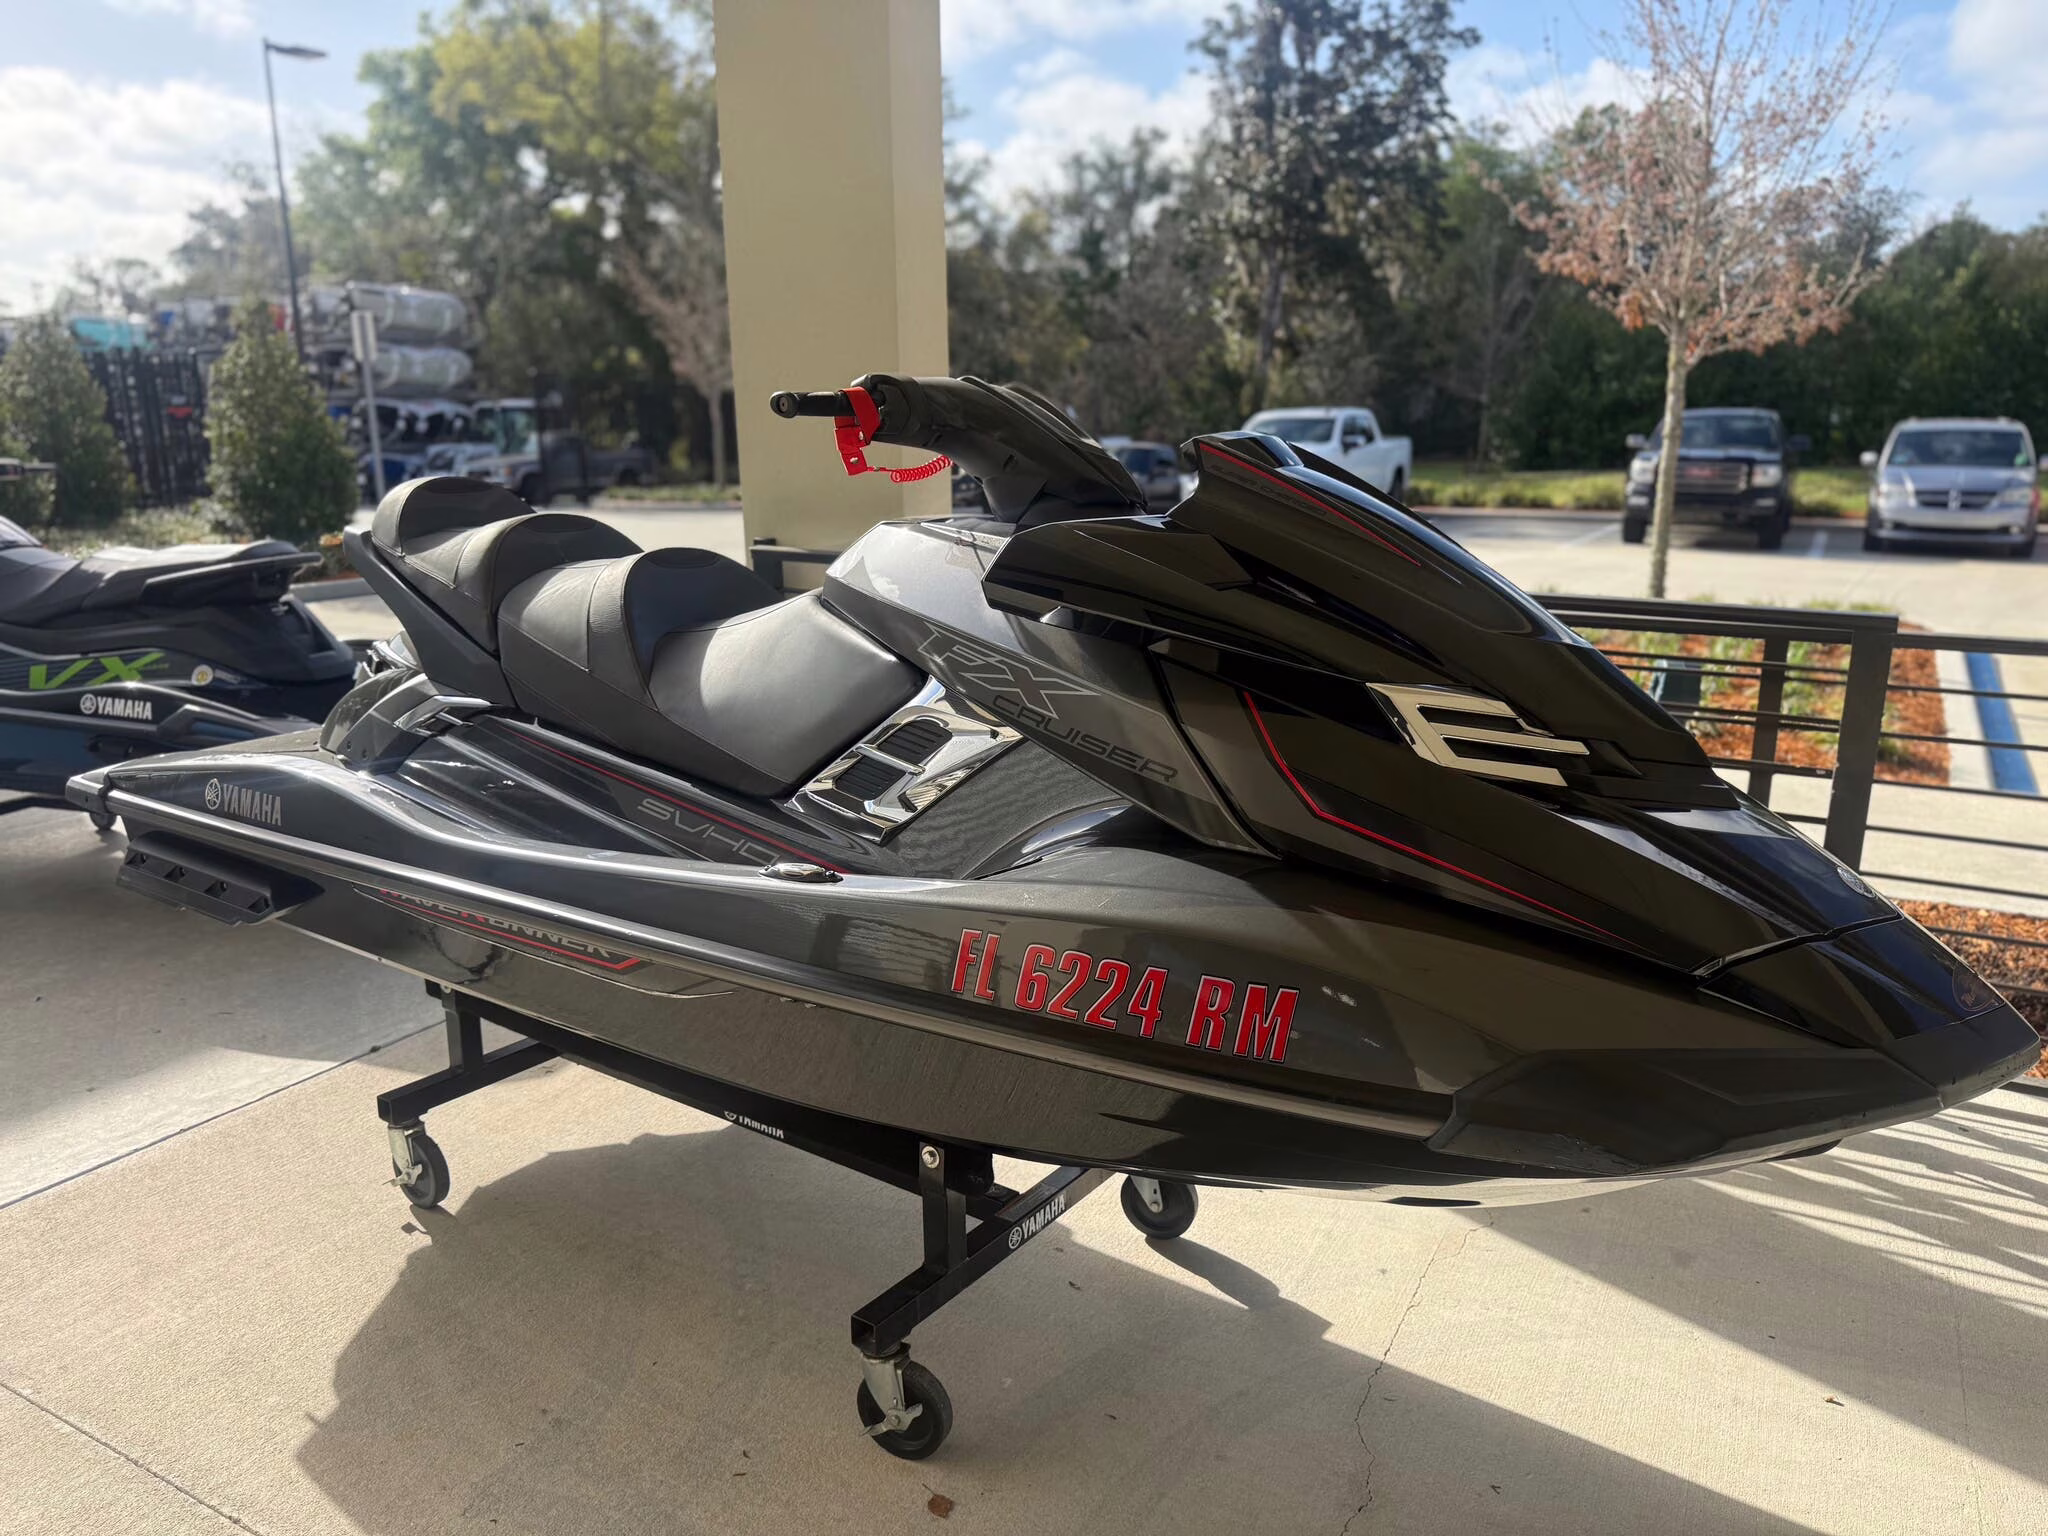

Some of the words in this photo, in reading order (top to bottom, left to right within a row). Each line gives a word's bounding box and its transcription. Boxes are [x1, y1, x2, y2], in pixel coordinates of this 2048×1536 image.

[28, 651, 166, 690] VX
[918, 621, 1100, 719] FX
[97, 696, 153, 721] YAMAHA
[992, 694, 1179, 782] CRUISER
[223, 783, 282, 826] YAMAHA
[637, 798, 782, 866] SVHO
[951, 927, 1001, 1001] FL
[1014, 943, 1169, 1040] 6224
[1185, 974, 1300, 1063] RM
[1022, 1194, 1066, 1239] YAMAHA
